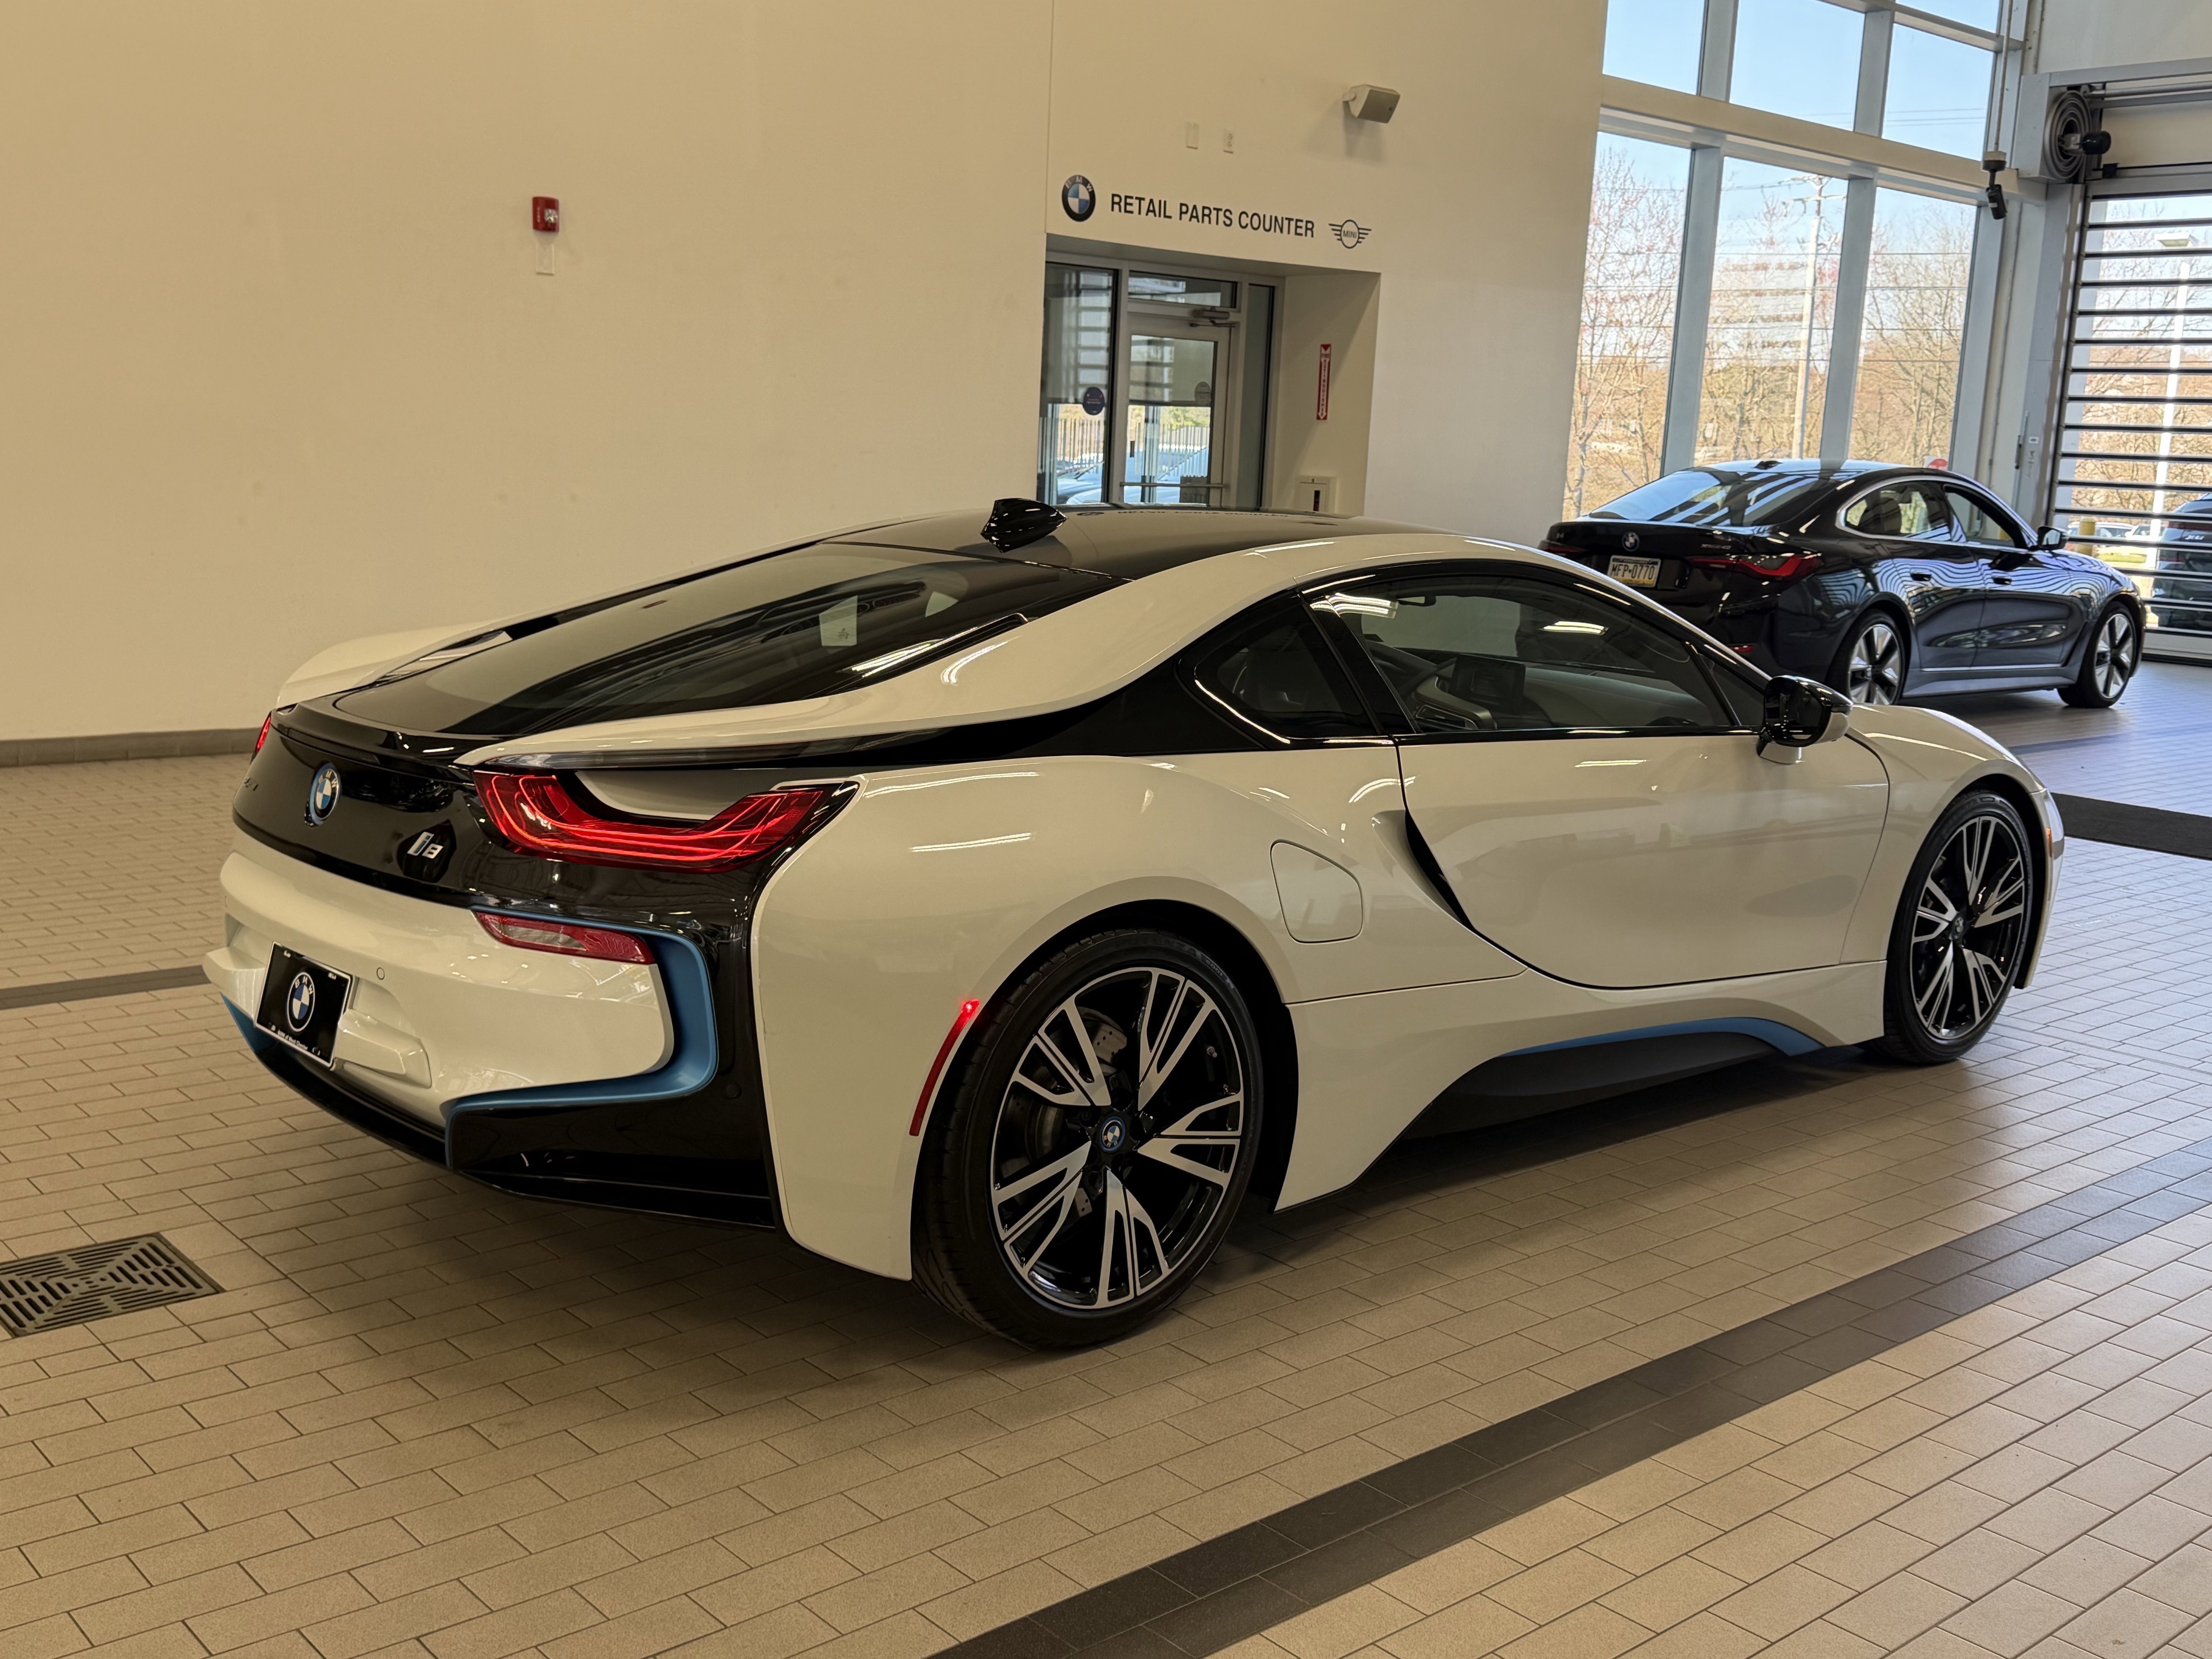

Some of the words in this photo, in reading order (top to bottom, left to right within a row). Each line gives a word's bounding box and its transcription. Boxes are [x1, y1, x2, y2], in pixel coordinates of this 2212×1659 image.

[1065, 175, 1094, 192] BMW
[1111, 193, 1172, 219] RETAIL
[1179, 203, 1233, 228] PARTS
[1239, 211, 1315, 238] COUNTER
[1342, 230, 1357, 239] MINI
[295, 975, 314, 995] BMW
